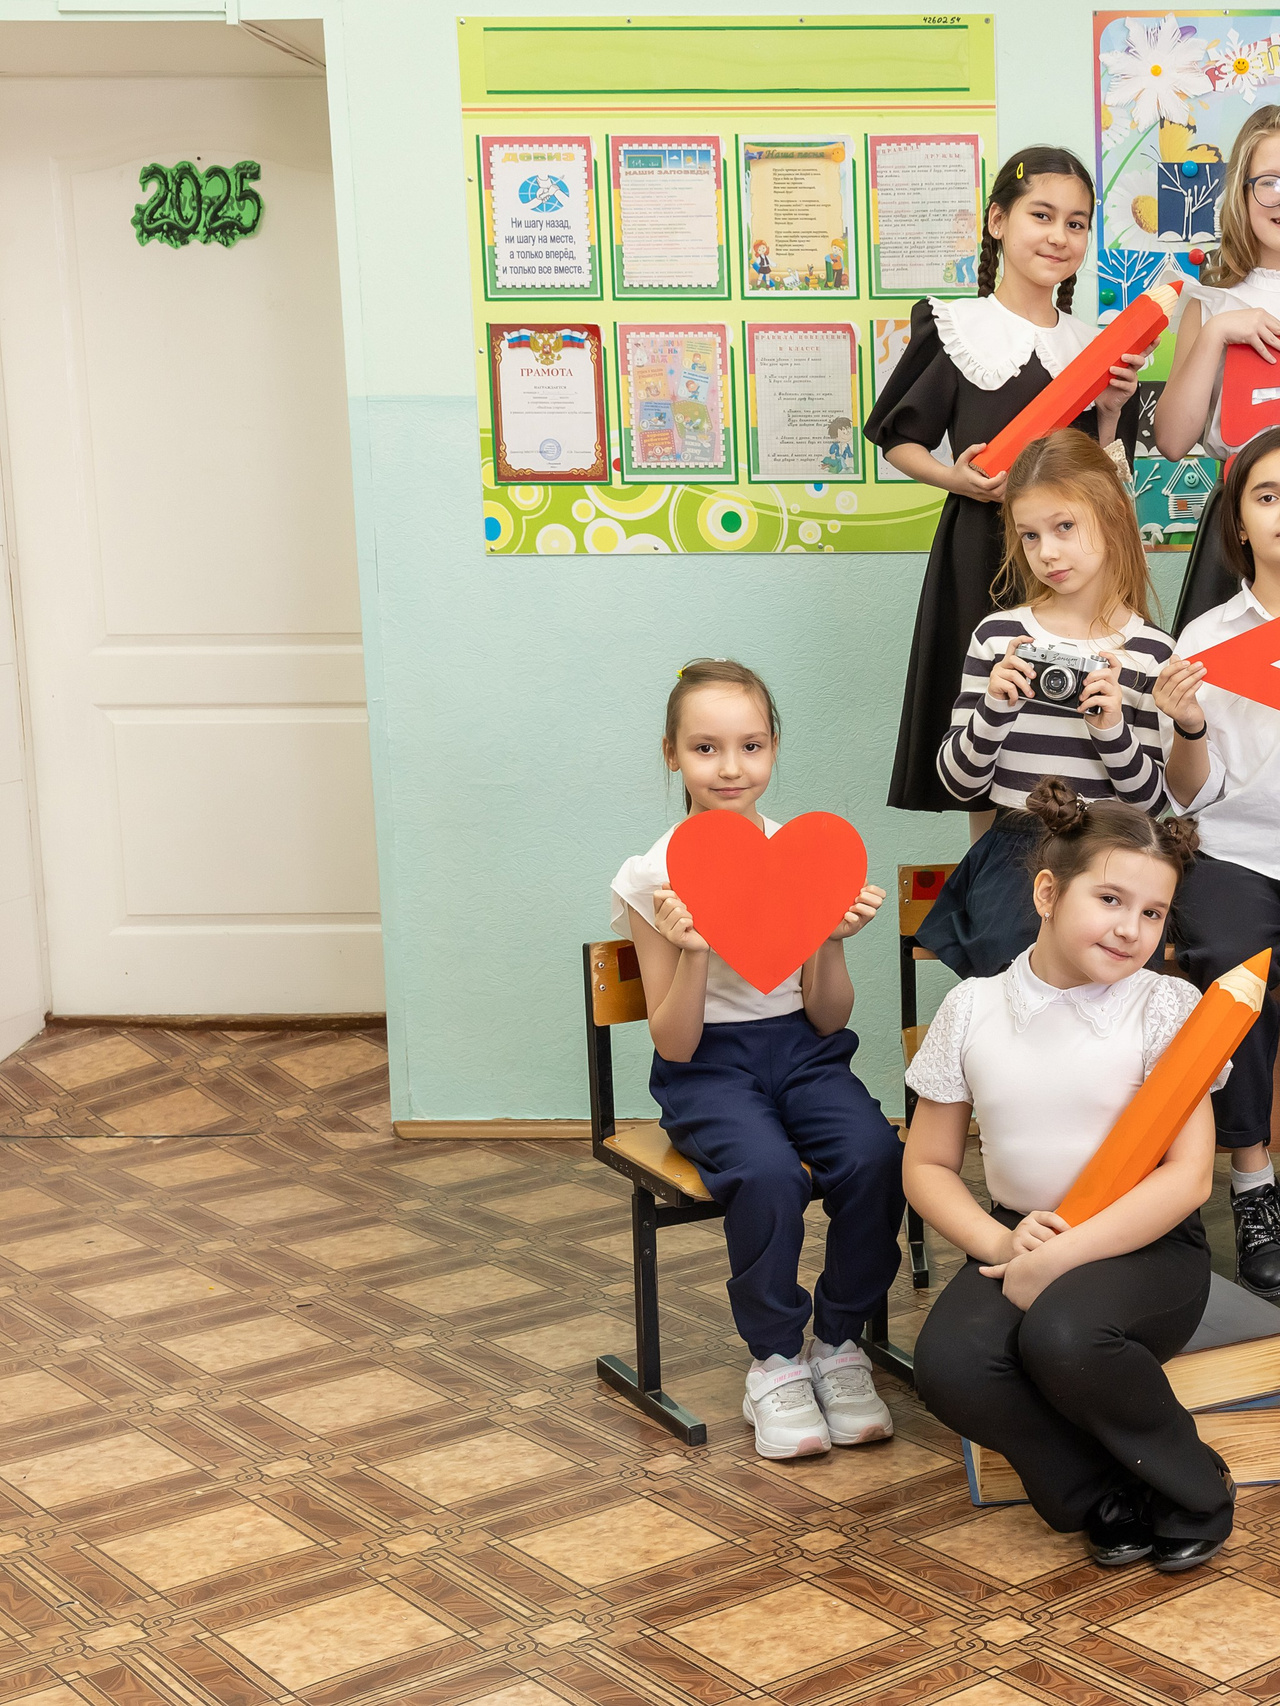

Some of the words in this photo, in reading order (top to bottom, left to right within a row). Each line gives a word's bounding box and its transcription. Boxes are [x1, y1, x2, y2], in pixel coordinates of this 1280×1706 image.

[765, 150, 795, 158] Наша
[134, 162, 264, 247] 2025
[510, 217, 522, 228] Ни
[524, 218, 544, 231] шагу
[546, 219, 572, 230] назад,
[504, 235, 515, 244] ни
[516, 235, 536, 246] шагу
[538, 235, 548, 244] на
[549, 235, 576, 246] месте,
[509, 251, 515, 259] а
[516, 250, 544, 259] только
[545, 247, 577, 262] вперёд,
[502, 266, 508, 274] и
[510, 266, 536, 274] только
[538, 265, 552, 274] все
[554, 264, 585, 274] вместе.
[520, 368, 574, 376] ГРАМОТА
[773, 1374, 786, 1384] TIME
